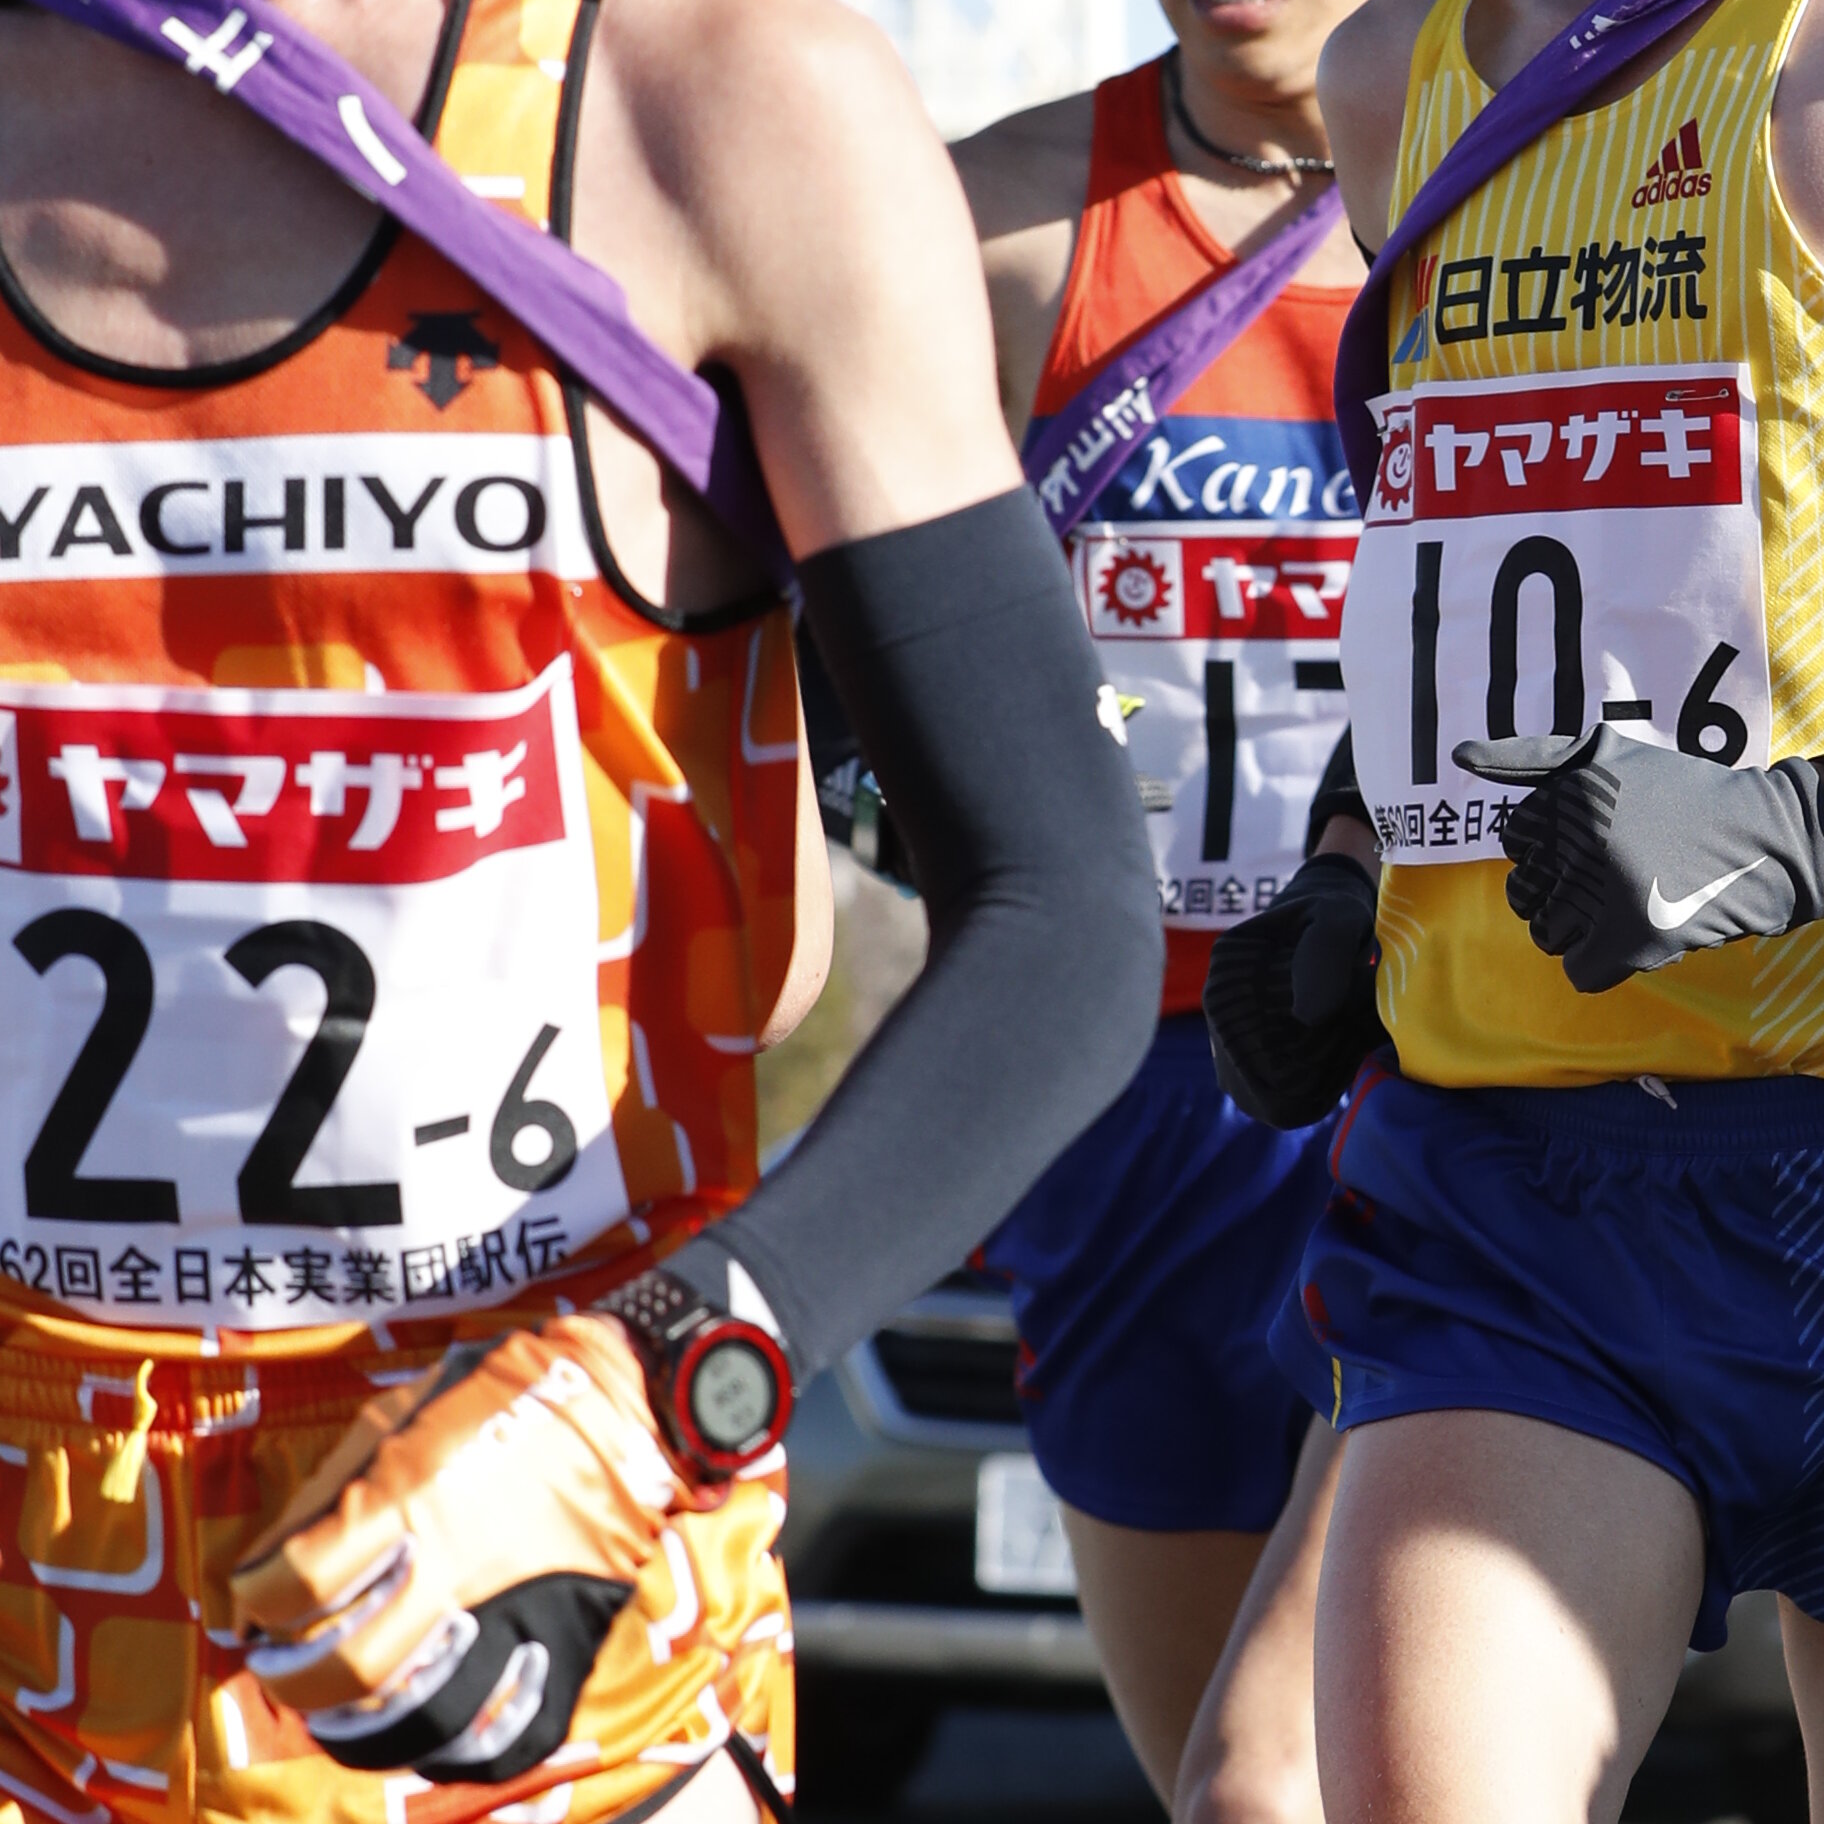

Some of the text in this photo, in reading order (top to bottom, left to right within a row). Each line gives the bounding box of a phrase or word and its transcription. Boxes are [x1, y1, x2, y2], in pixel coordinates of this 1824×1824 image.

[1631, 170, 1713, 210] adidas
[1434, 230, 1708, 346] 日立物流
[1424, 409, 1714, 489] ヤマザキ
[0, 475, 547, 559] YACHIYO
[48, 739, 529, 851] ヤマザキ
